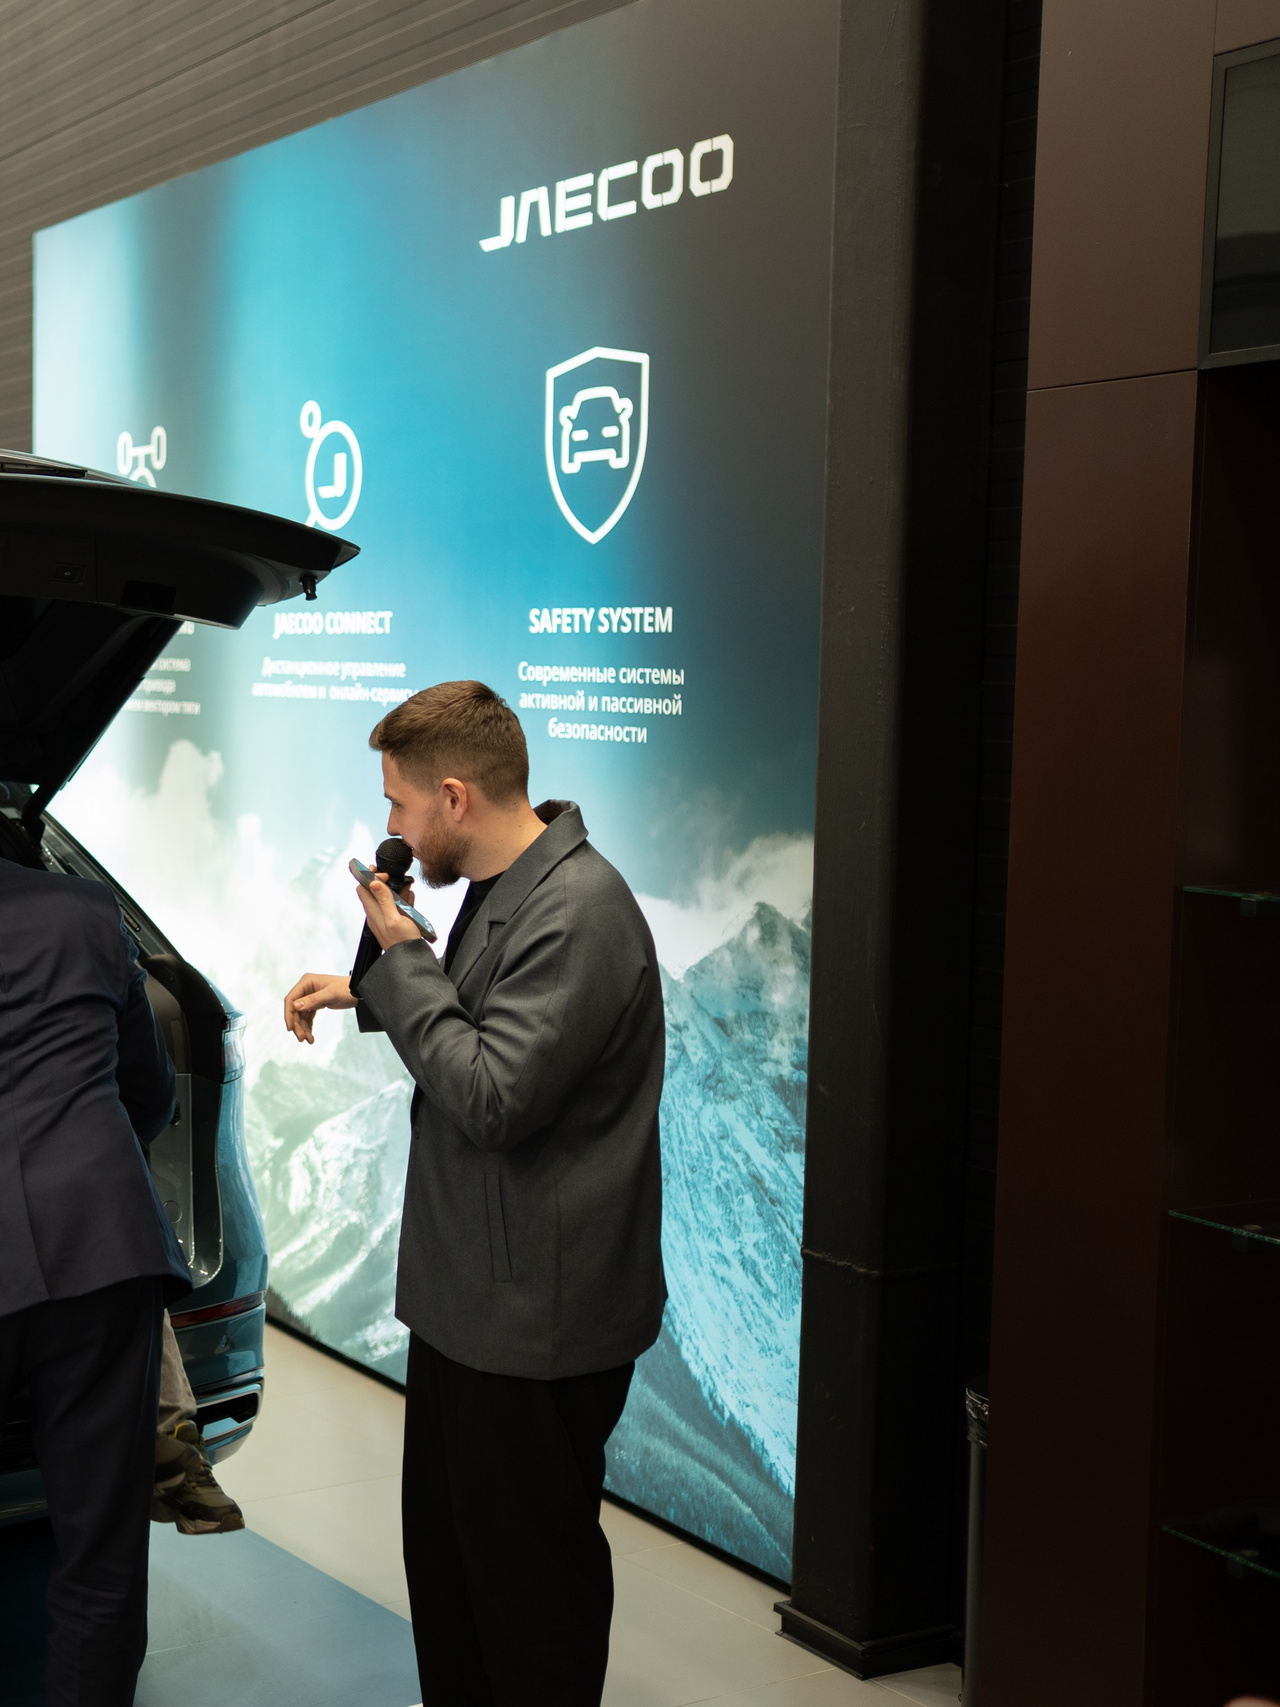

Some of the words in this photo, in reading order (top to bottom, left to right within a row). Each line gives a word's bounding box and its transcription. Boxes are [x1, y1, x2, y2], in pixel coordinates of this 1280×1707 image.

[479, 133, 734, 252] JAECOO
[273, 612, 323, 640] JAECOO
[325, 611, 393, 635] CONNECT
[529, 607, 595, 634] SAFETY
[598, 606, 673, 634] SYSTEM
[340, 661, 406, 681] управление
[518, 661, 616, 687] Современные
[619, 667, 685, 685] системы
[319, 685, 327, 700] и
[519, 690, 585, 712] активной
[588, 696, 598, 712] и
[601, 693, 682, 716] пассивной
[548, 717, 648, 744] безопасности
